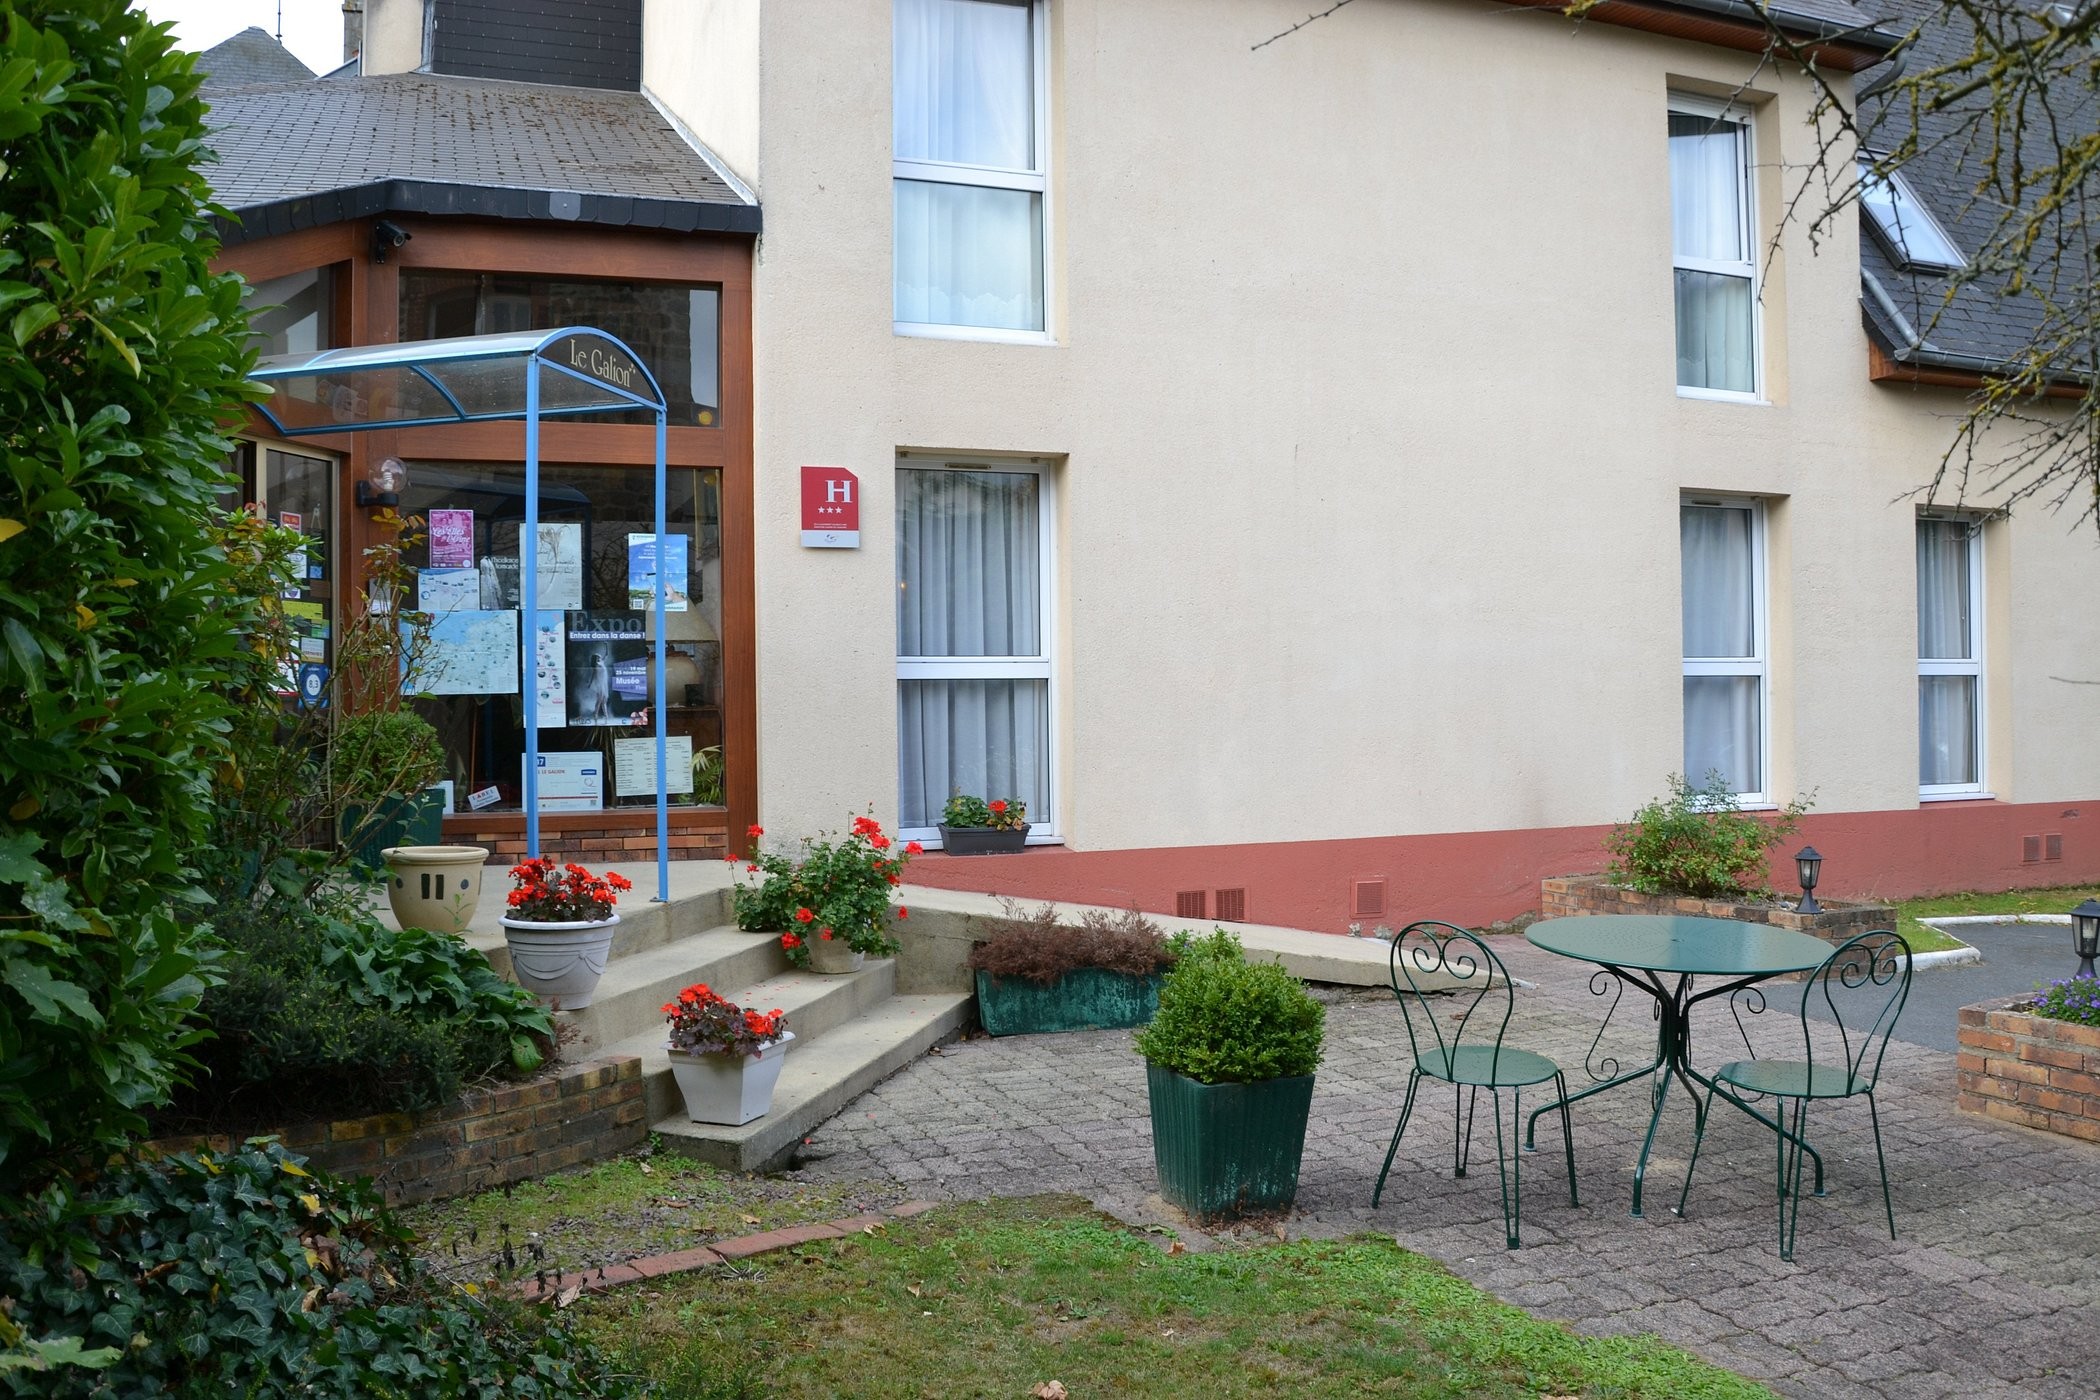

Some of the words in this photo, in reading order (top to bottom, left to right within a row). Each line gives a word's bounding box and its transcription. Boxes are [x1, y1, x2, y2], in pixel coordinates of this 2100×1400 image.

[570, 338, 587, 369] Le
[591, 349, 631, 388] Galion
[825, 479, 852, 503] H
[570, 611, 641, 633] Expo
[308, 679, 319, 690] 8,3
[615, 676, 640, 685] Musée
